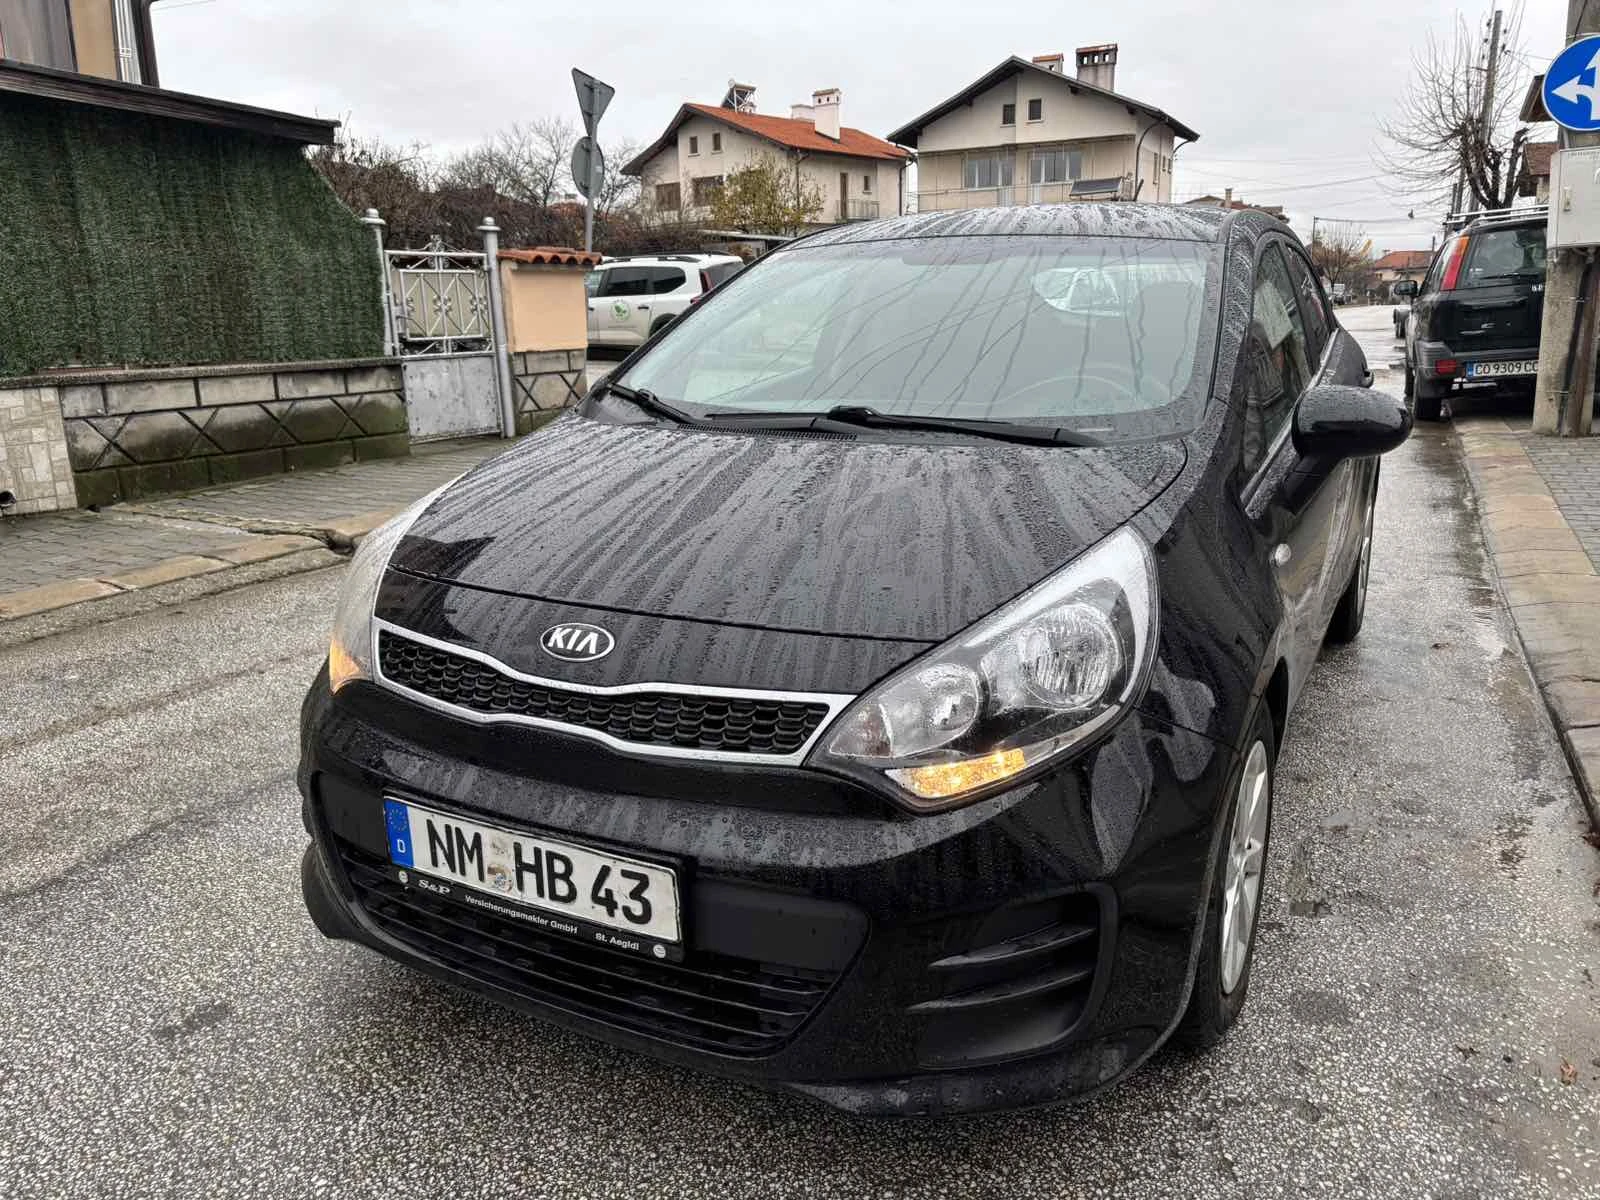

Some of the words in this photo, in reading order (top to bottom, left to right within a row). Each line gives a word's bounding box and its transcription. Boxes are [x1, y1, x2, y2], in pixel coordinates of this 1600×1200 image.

[1493, 362, 1522, 374] 9309
[547, 627, 599, 655] KIA
[397, 839, 406, 853] D
[426, 819, 485, 882] NM
[512, 841, 578, 904] HB
[591, 865, 653, 925] 43
[464, 894, 549, 926] Versicherungsmakler
[550, 920, 578, 934] GmbH
[595, 932, 608, 943] St.
[609, 936, 640, 951] Aegidi
